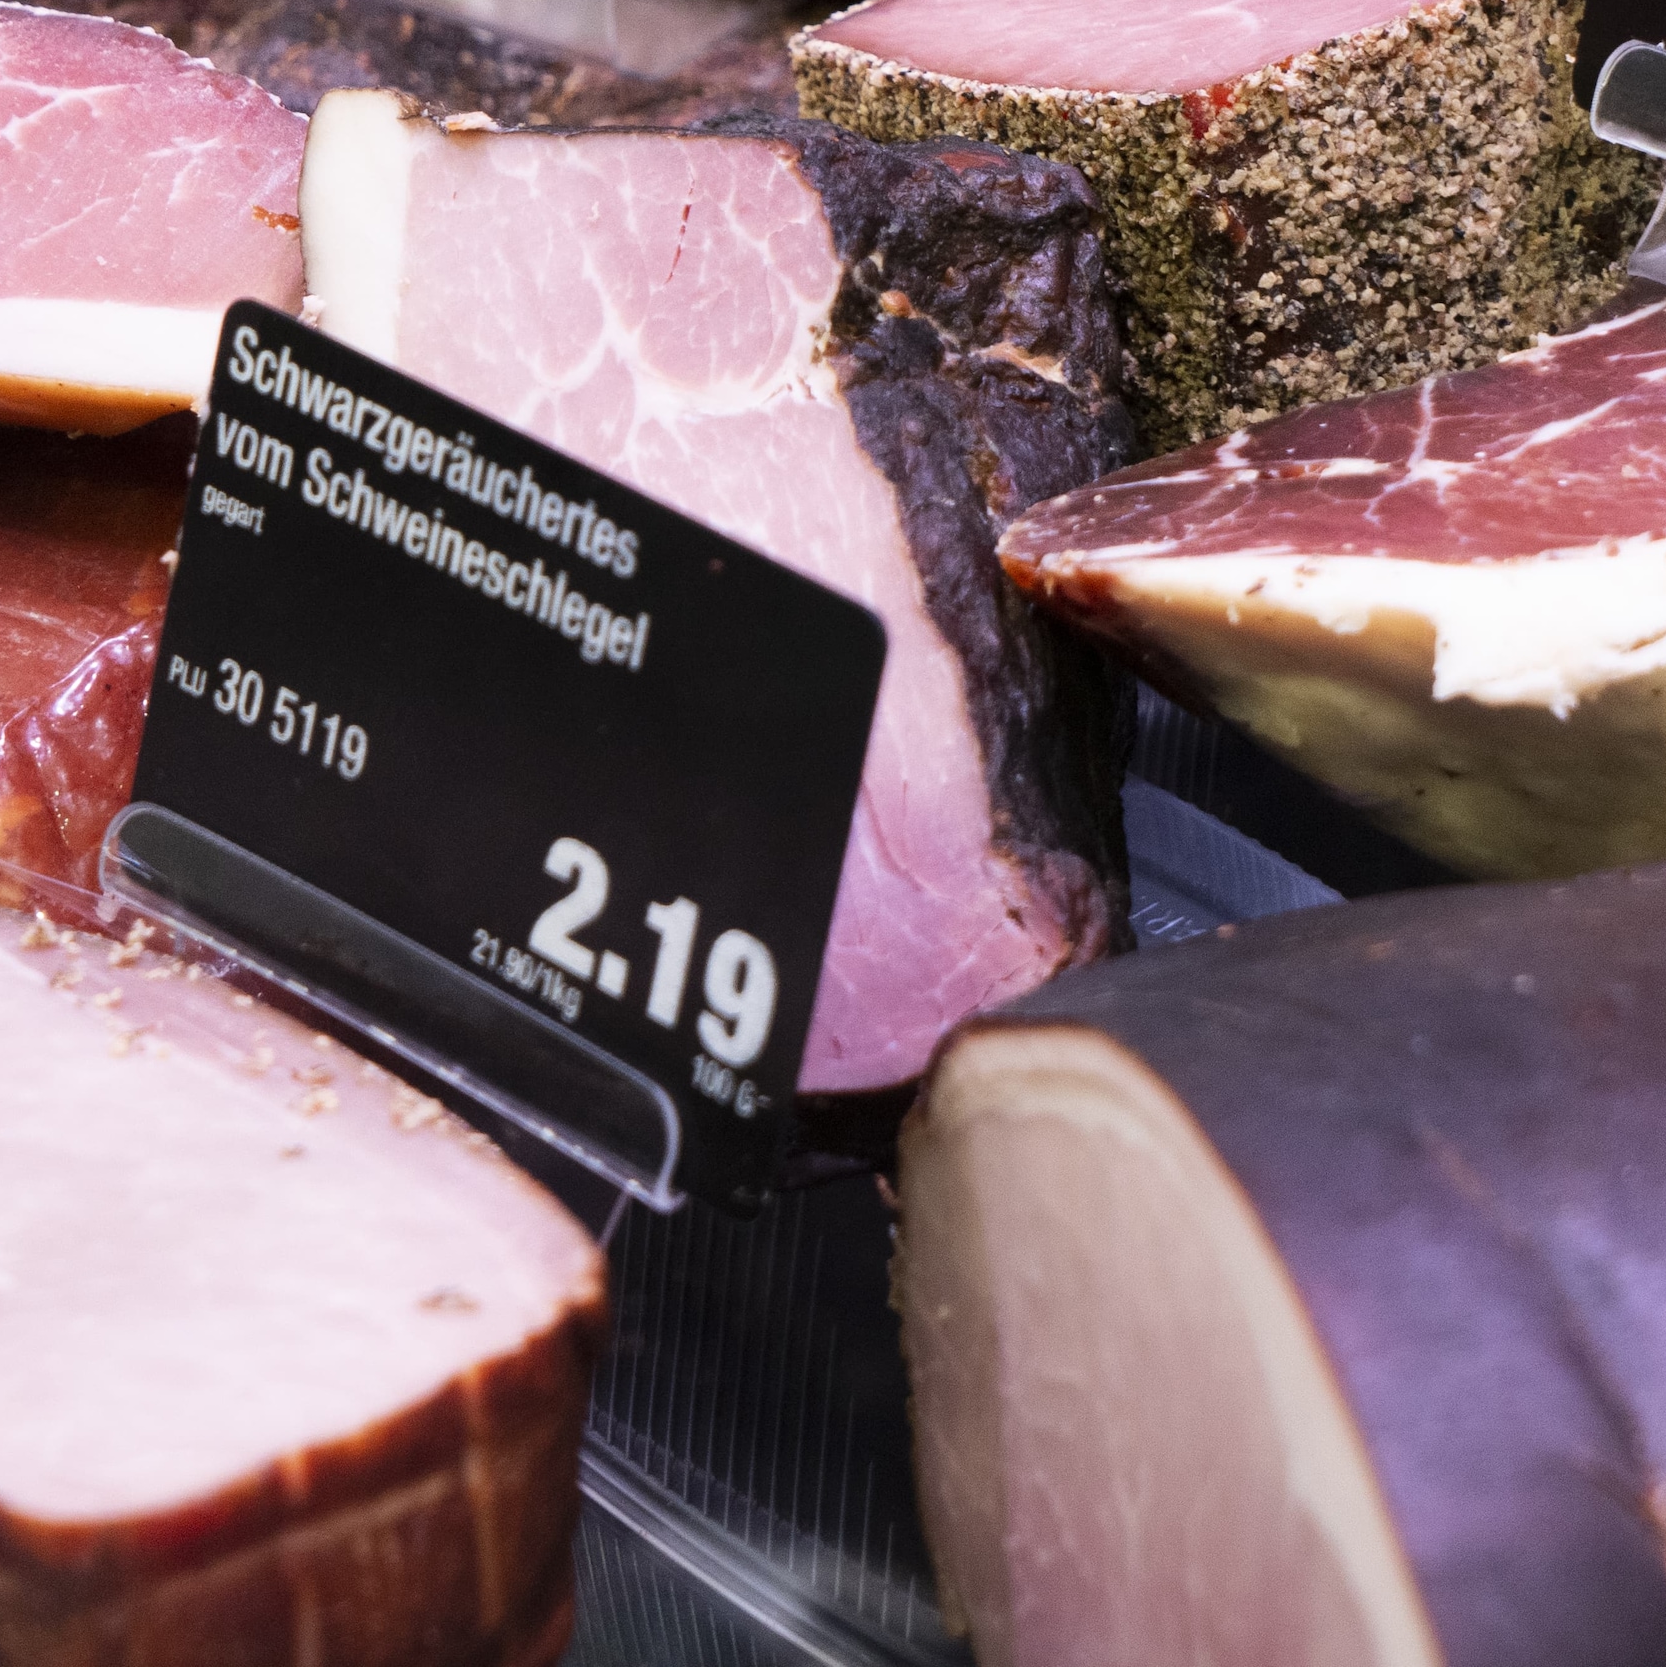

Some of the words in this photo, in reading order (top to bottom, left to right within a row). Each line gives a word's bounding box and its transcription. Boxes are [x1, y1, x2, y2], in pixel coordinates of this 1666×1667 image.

[201, 482, 265, 535] gegart
[228, 326, 642, 580] Schwarzgeräuchertes
[216, 411, 295, 488] vom
[301, 456, 649, 671] Schweineschlegel
[168, 655, 207, 698] PLU
[213, 657, 265, 726] 30
[270, 686, 369, 781] 5119
[471, 928, 582, 1022] 21.90/1kg
[531, 836, 777, 1067] 2.19
[692, 1054, 734, 1105] 100
